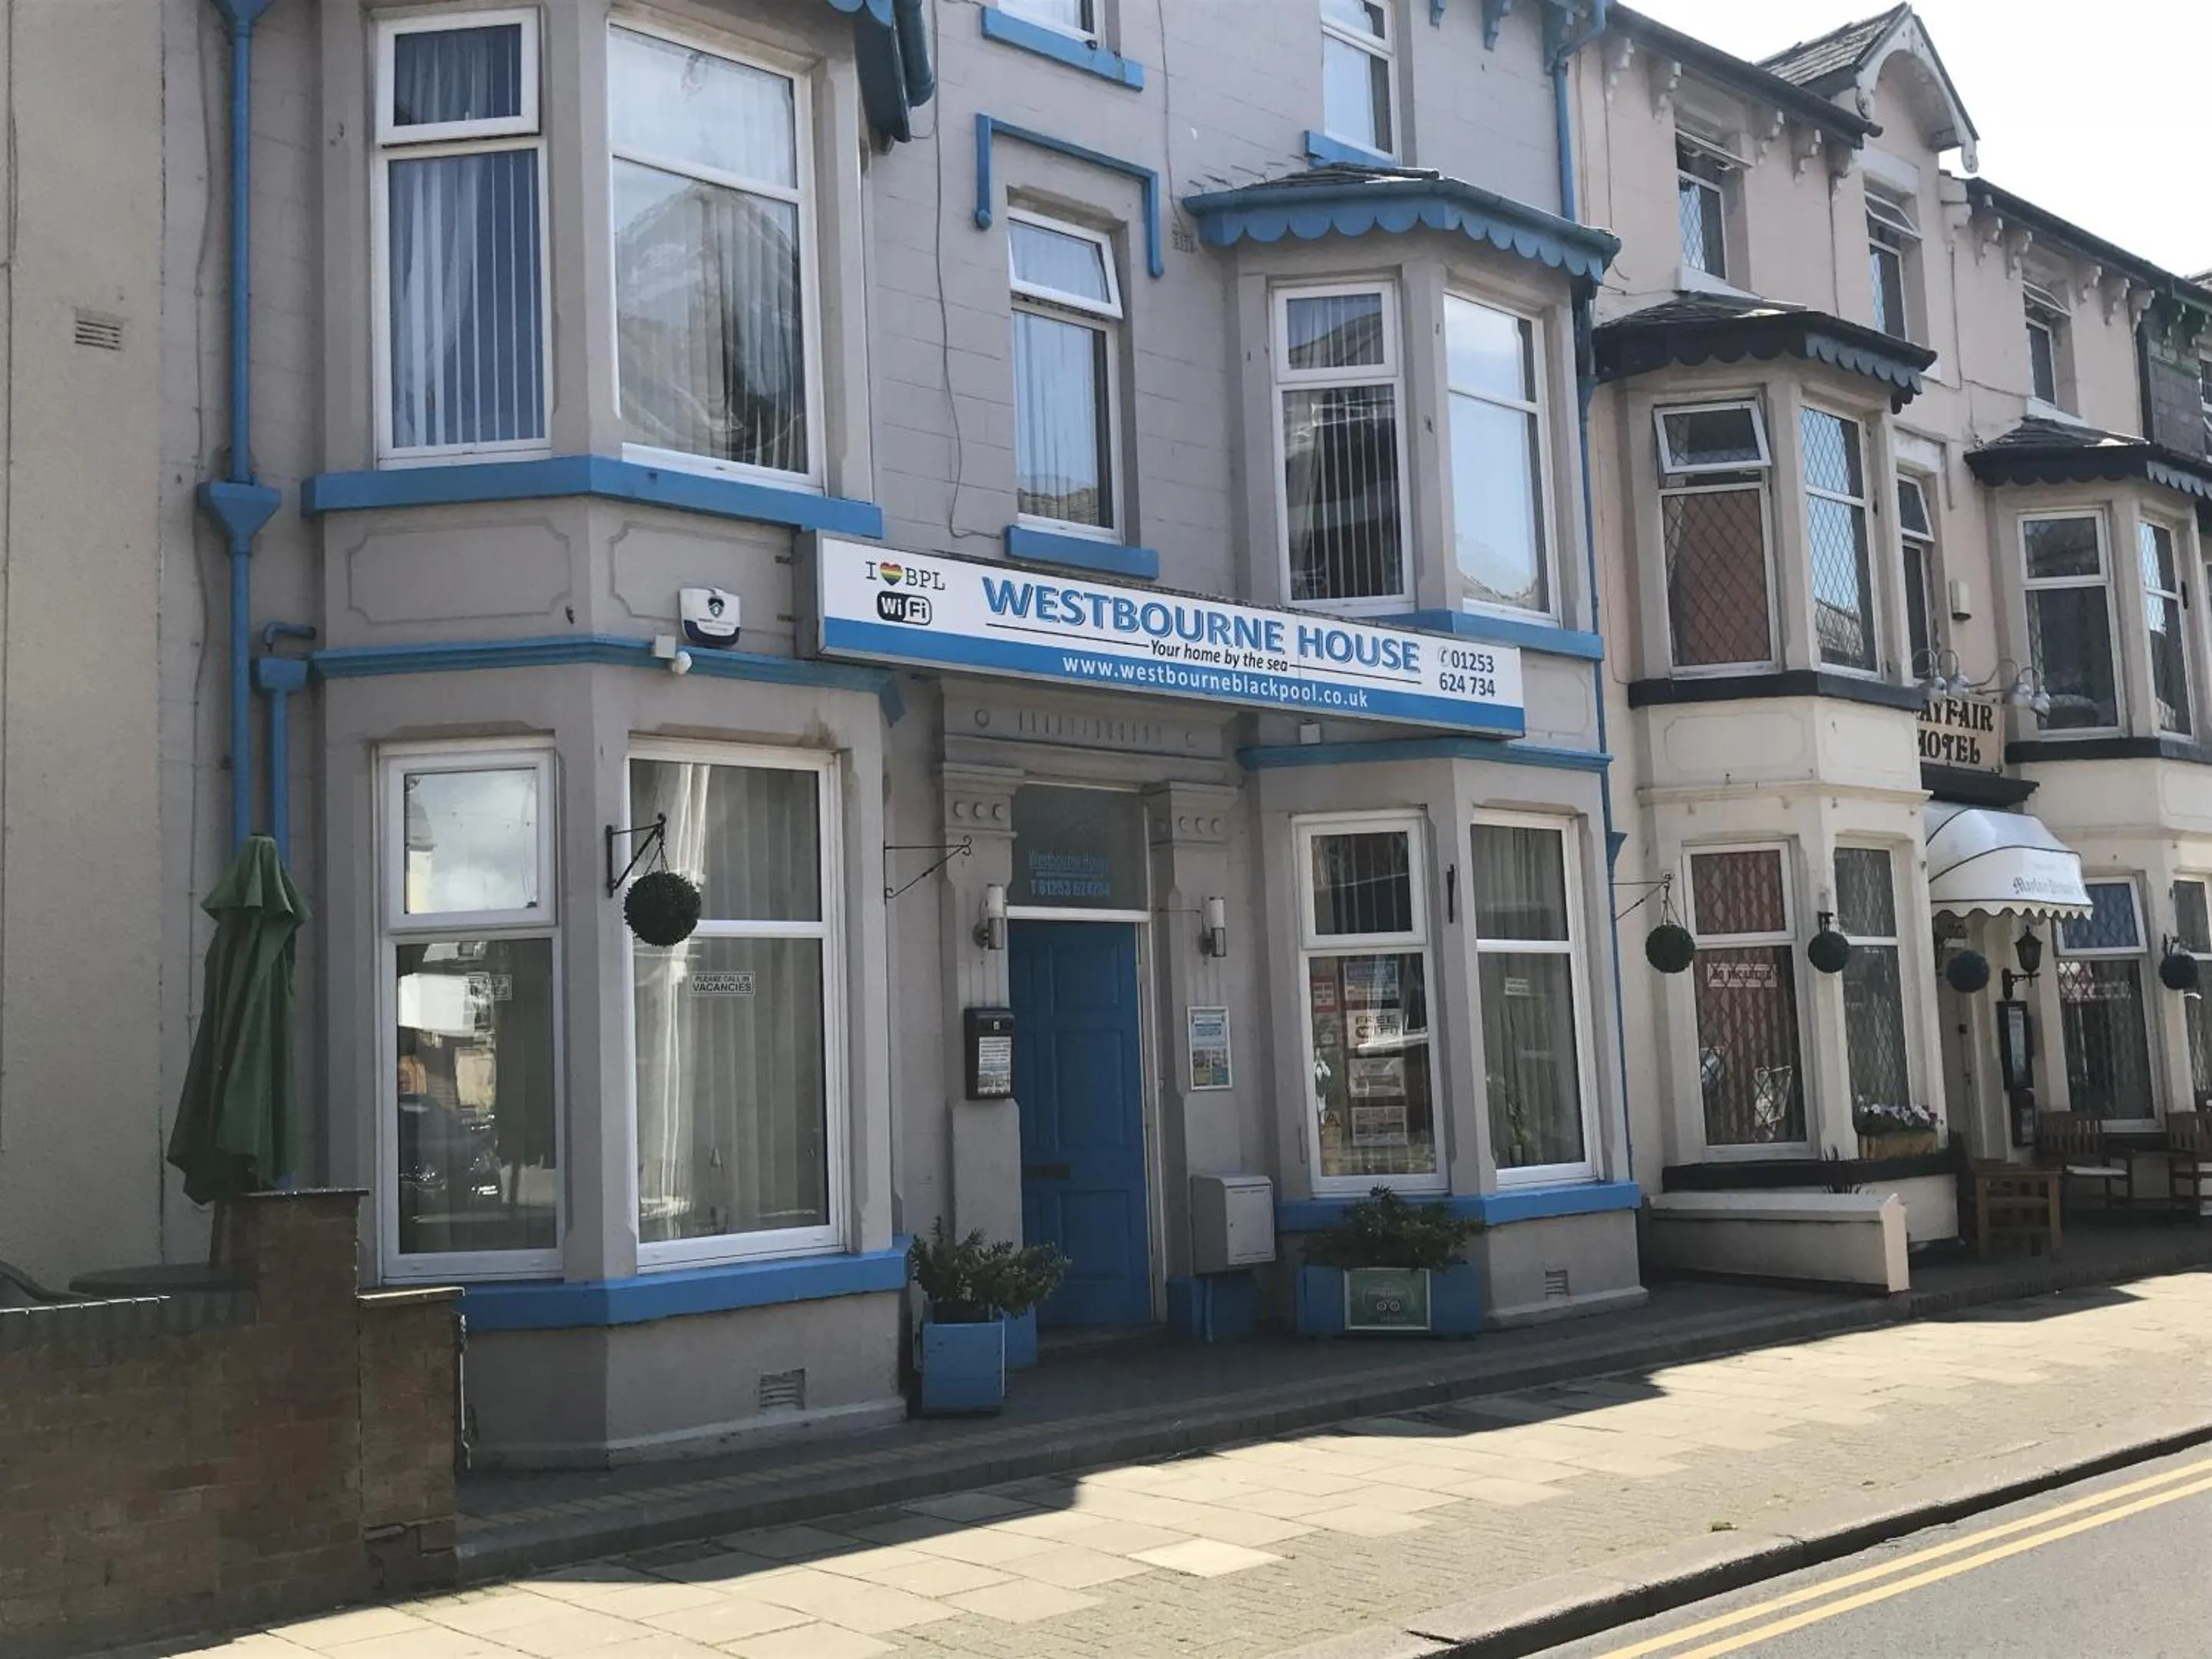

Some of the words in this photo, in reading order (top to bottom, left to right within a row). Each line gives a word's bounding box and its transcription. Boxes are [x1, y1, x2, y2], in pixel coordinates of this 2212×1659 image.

[904, 567, 946, 590] BPL
[982, 576, 1285, 656] WESTBOURNE
[1298, 624, 1421, 674] HOUSE
[1150, 639, 1180, 657] Your
[1183, 646, 1221, 663] home
[1225, 650, 1239, 668] by
[1242, 653, 1264, 669] the
[1267, 659, 1289, 673] sea
[1451, 649, 1495, 673] 01253
[1063, 656, 1369, 708] www.westbourneblackpool.co.uk
[1439, 672, 1466, 694] 624
[1470, 676, 1496, 697] 734
[1917, 698, 1994, 732] AYFAIR
[693, 983, 751, 992] VACANCIES
